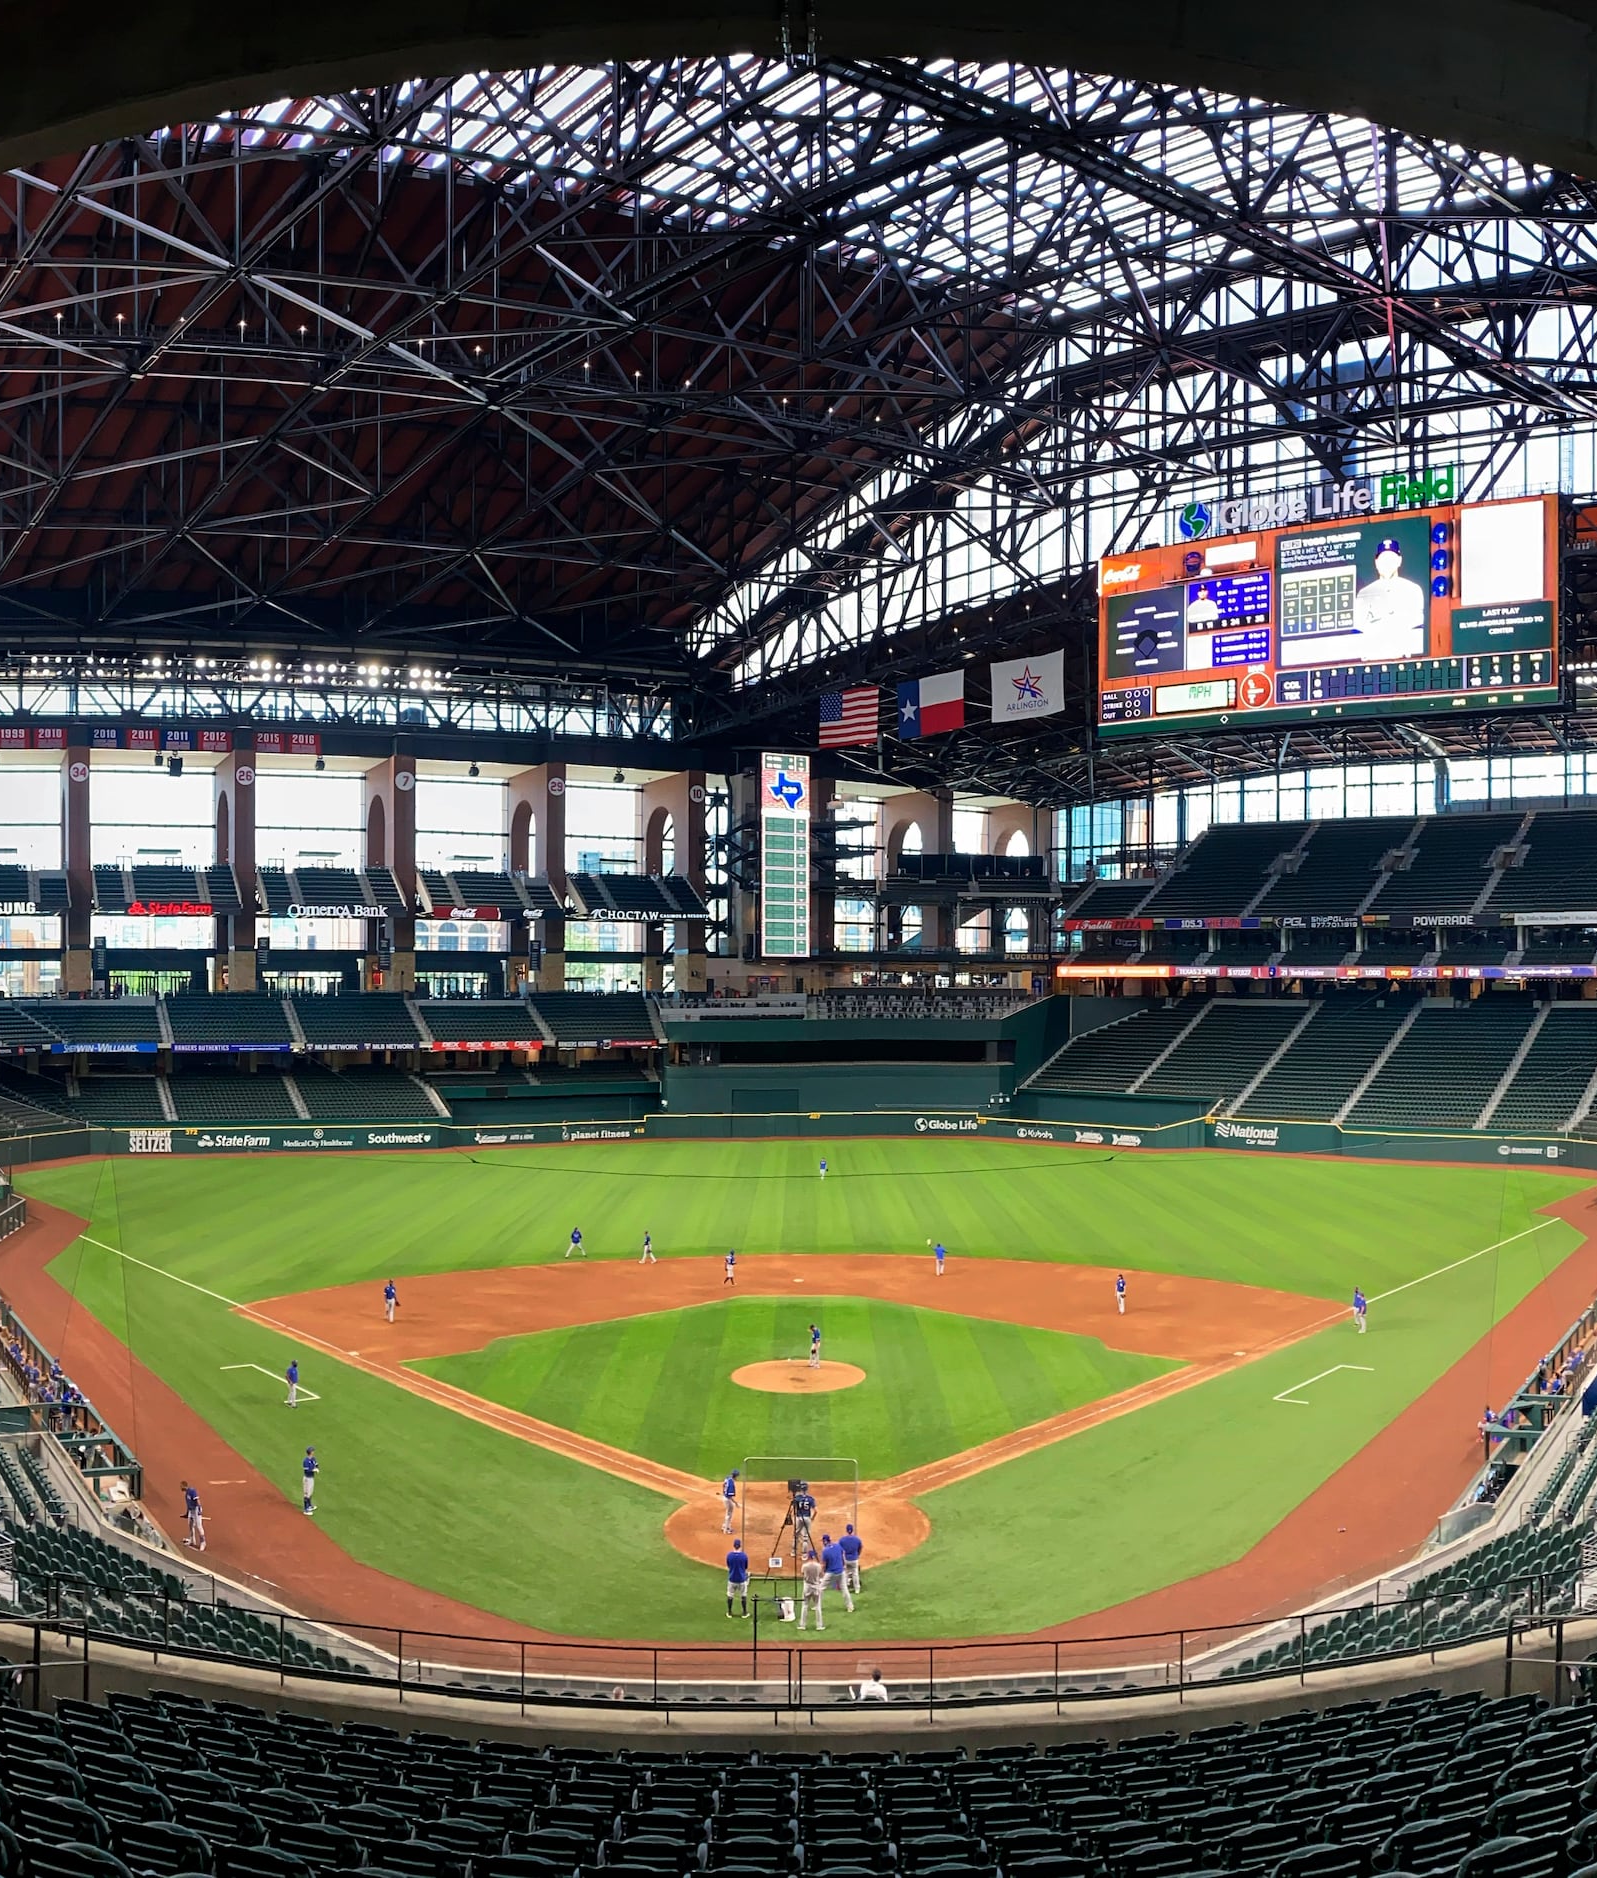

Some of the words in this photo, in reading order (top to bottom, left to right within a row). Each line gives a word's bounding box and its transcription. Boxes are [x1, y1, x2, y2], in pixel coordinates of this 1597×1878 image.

[1219, 495, 1307, 529] Globe
[1315, 482, 1372, 514] Life
[1381, 466, 1453, 507] Field
[1103, 693, 1118, 701] BALL
[1189, 685, 1212, 699] MPH
[1006, 699, 1049, 712] ARLINGTON
[1103, 702, 1123, 710] STRIKE
[1103, 712, 1117, 720] OUT
[0, 728, 26, 739] 1999
[38, 728, 63, 739] 2010
[93, 729, 117, 739] 2010
[131, 730, 154, 741] 2011
[166, 731, 189, 742] 2011
[203, 731, 227, 742] 2012
[257, 733, 280, 744] 2015
[292, 734, 315, 745] 2016
[72, 767, 87, 778] 34
[238, 770, 253, 781] 26
[402, 775, 410, 787] 7
[550, 781, 563, 792] 29
[692, 788, 702, 799] 10
[354, 904, 389, 918] Bank
[598, 908, 659, 920] CHOCTAW
[1080, 918, 1113, 931] Fratelli
[1181, 918, 1203, 929] 105.3
[1283, 917, 1306, 928] PGL
[1310, 915, 1358, 923] ShipPGL.com
[1413, 915, 1474, 927] POWERADE
[1004, 953, 1050, 962] PLUCKERS
[328, 1043, 358, 1051] NETWORK
[929, 1119, 958, 1130] Globe
[959, 1119, 978, 1130] Life
[129, 1130, 146, 1138] BUD
[146, 1130, 172, 1138] LIGHT
[368, 1132, 423, 1145] Southwest
[570, 1130, 600, 1141] planet
[600, 1129, 631, 1139] fitness
[1027, 1129, 1053, 1140] Kubota
[129, 1136, 172, 1153] SELTZER
[320, 1139, 353, 1148] Healthcare
[1257, 1139, 1277, 1147] Rental
